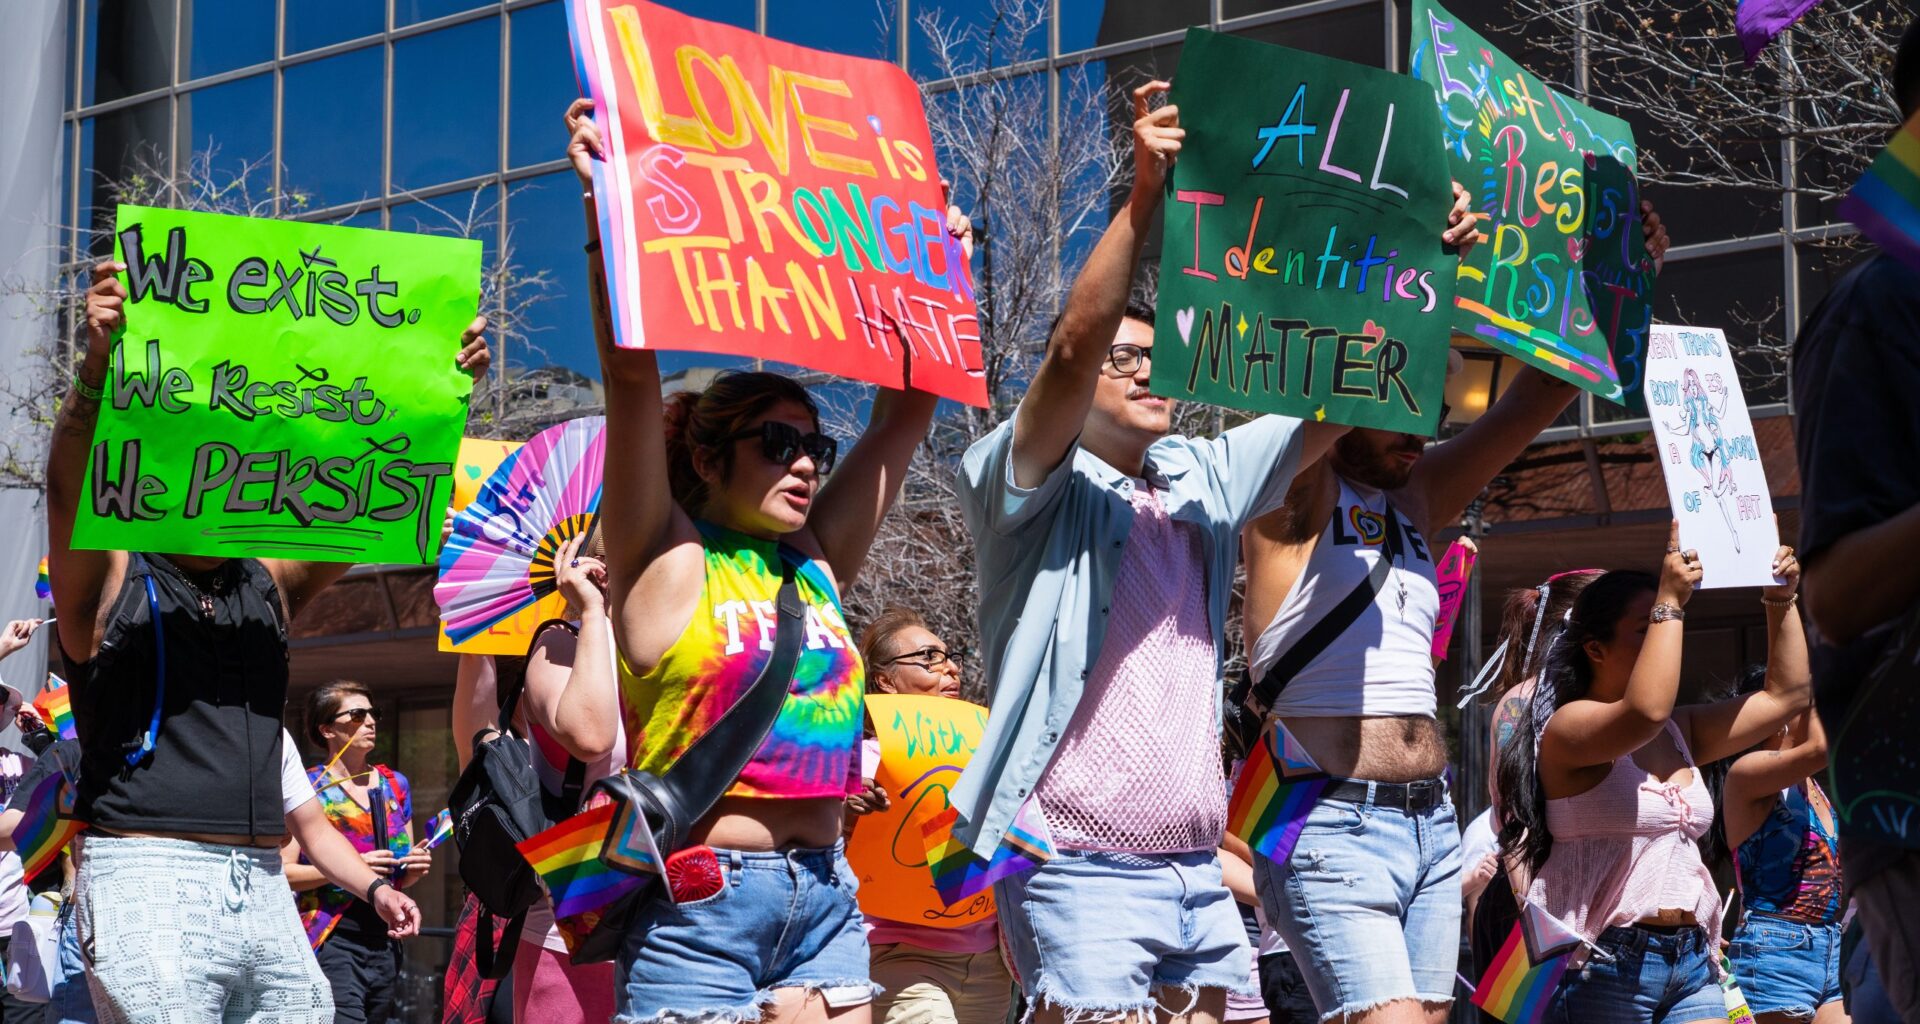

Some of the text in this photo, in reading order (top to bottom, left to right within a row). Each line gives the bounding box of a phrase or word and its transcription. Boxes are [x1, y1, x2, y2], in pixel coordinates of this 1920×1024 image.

[607, 5, 878, 176] LOVE
[1251, 82, 1408, 200] ALL
[119, 224, 213, 314] We
[637, 143, 974, 304] STRONGER
[1177, 190, 1437, 312] Identities
[644, 236, 986, 379] THAN HATE
[1187, 301, 1422, 416] MATTER
[111, 339, 193, 413] We
[1649, 379, 1681, 406] BODY
[91, 439, 168, 522] We
[184, 433, 452, 564] PERSIST
[1683, 490, 1702, 513] OF
[714, 599, 859, 656] TEAS
[892, 710, 977, 760] With
